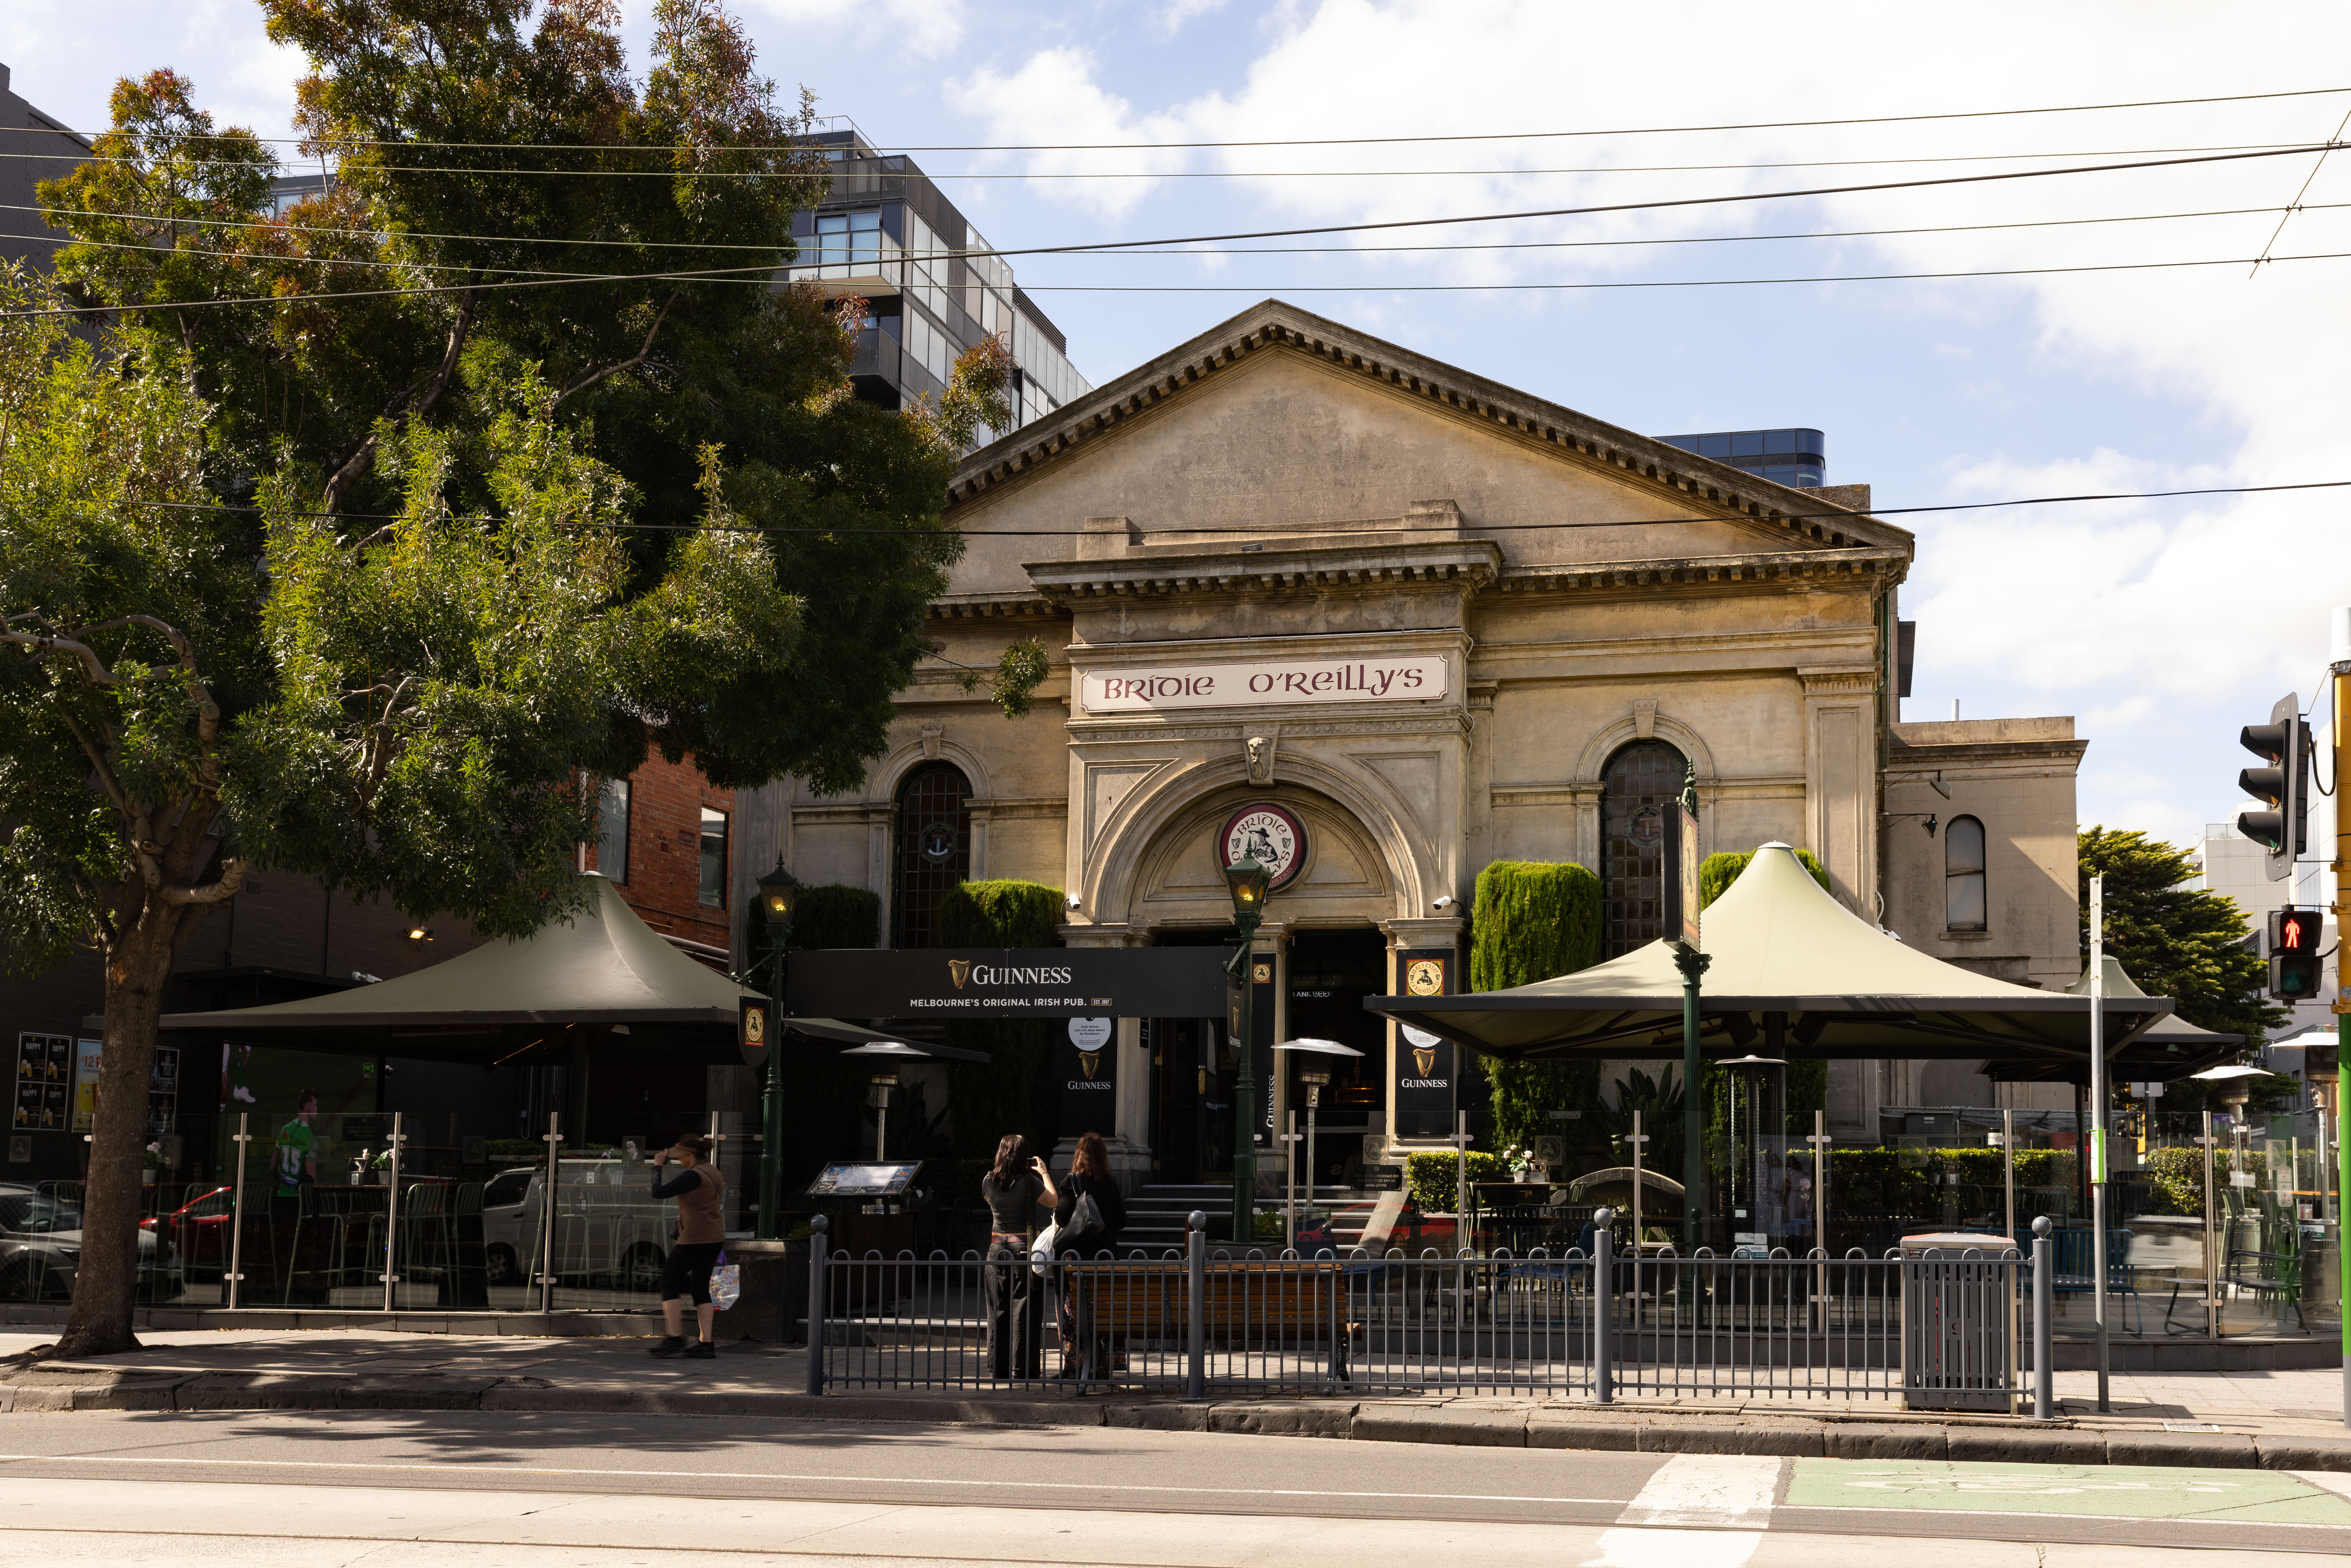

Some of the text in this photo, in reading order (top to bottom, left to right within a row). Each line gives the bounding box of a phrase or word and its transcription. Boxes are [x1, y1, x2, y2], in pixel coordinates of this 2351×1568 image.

[1270, 866, 1293, 885] DITION
[973, 965, 1071, 985] GUINNESS
[25, 1042, 41, 1050] HAPPY
[1230, 1036, 1241, 1048] GUINNESS
[52, 1044, 65, 1052] HAPPY
[1067, 1081, 1110, 1090] GUINNESS
[1402, 1078, 1447, 1088] GUINNESS
[22, 1089, 38, 1097] HAPPY
[49, 1091, 62, 1099] HAPPY
[1266, 1075, 1275, 1128] GUINNESS
[282, 1145, 301, 1175] 15
